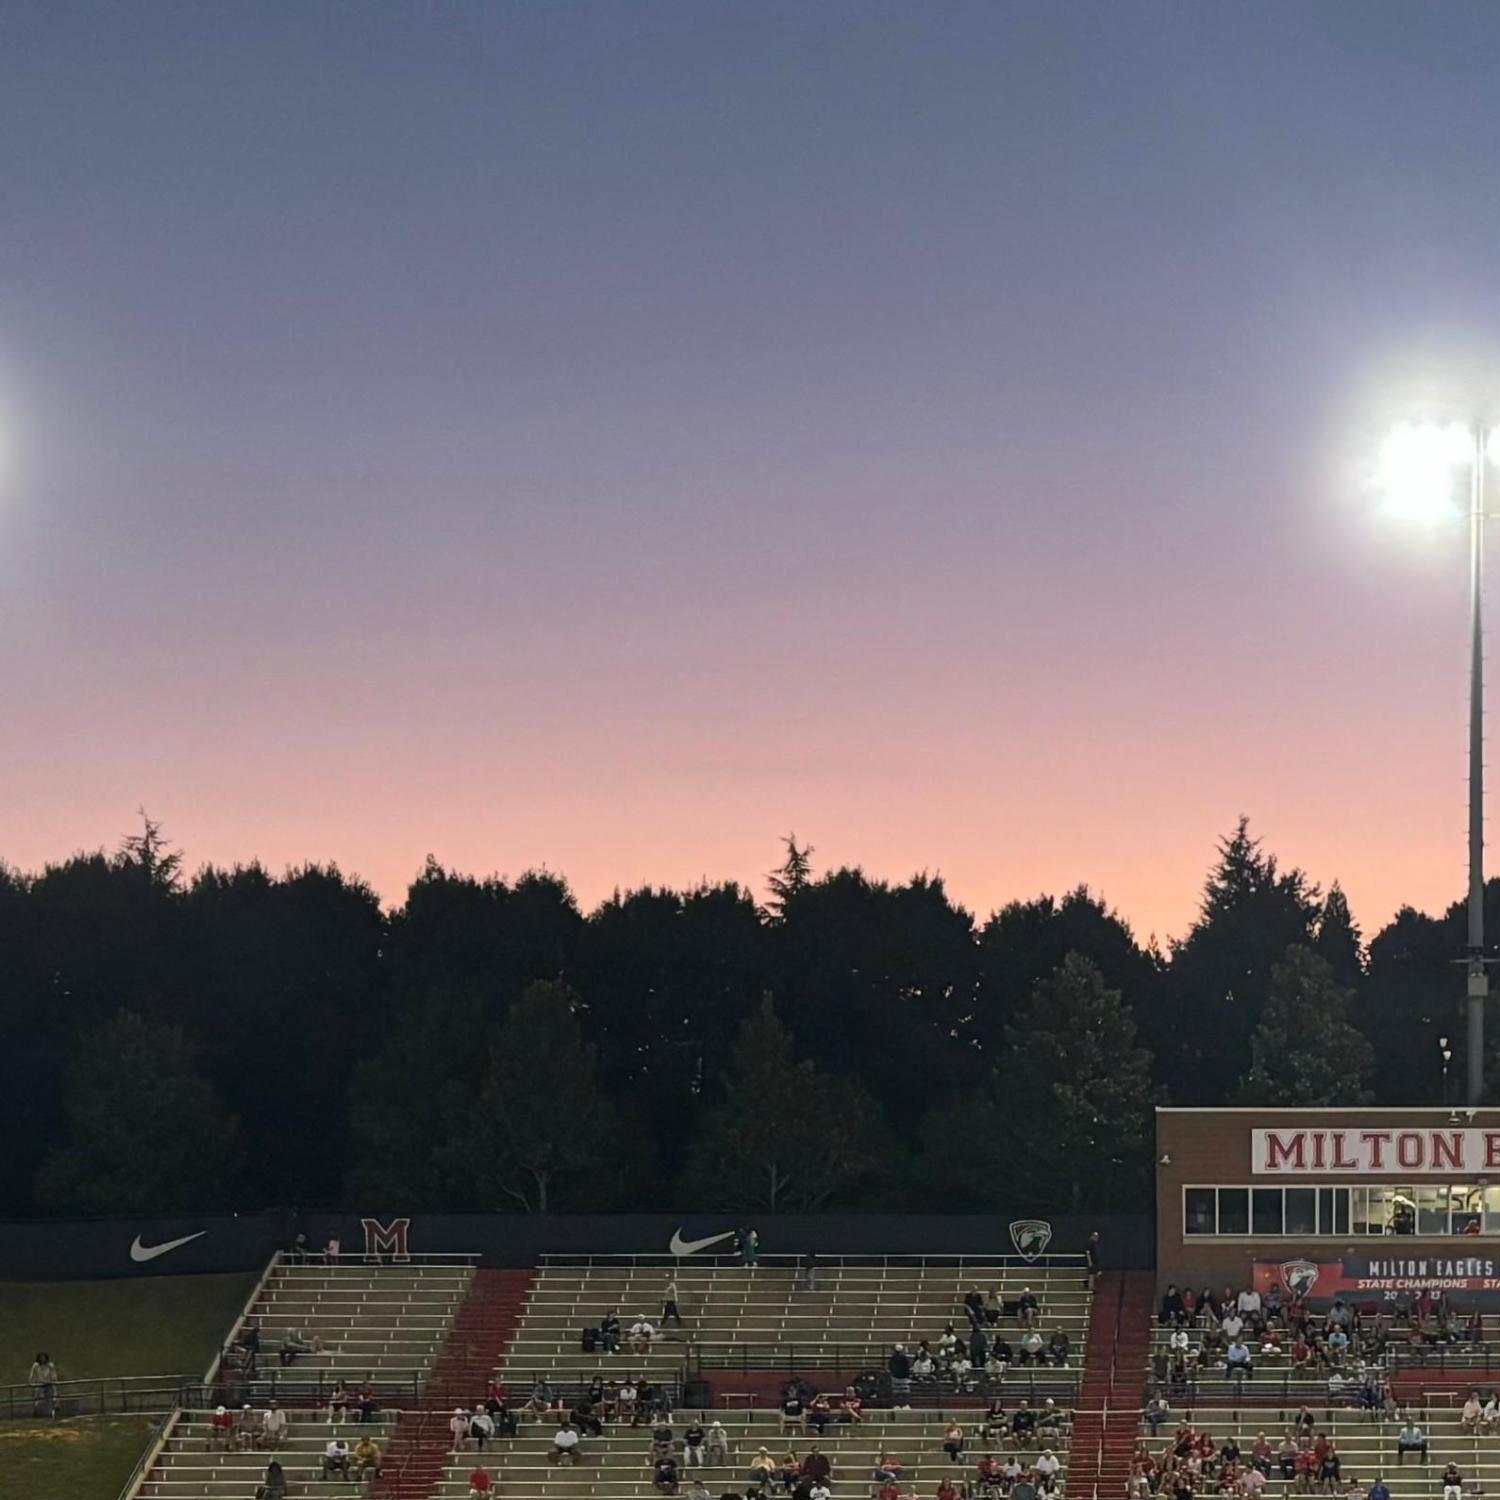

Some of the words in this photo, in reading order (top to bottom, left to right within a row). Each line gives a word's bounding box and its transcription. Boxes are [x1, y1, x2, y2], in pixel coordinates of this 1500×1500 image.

[1264, 1131, 1466, 1170] MILTON
[361, 1218, 411, 1262] M
[1369, 1260, 1427, 1276] MILTON
[1437, 1260, 1493, 1276] EAGLES
[1357, 1279, 1394, 1289] STATE
[1396, 1279, 1468, 1289] CHAMPIONS
